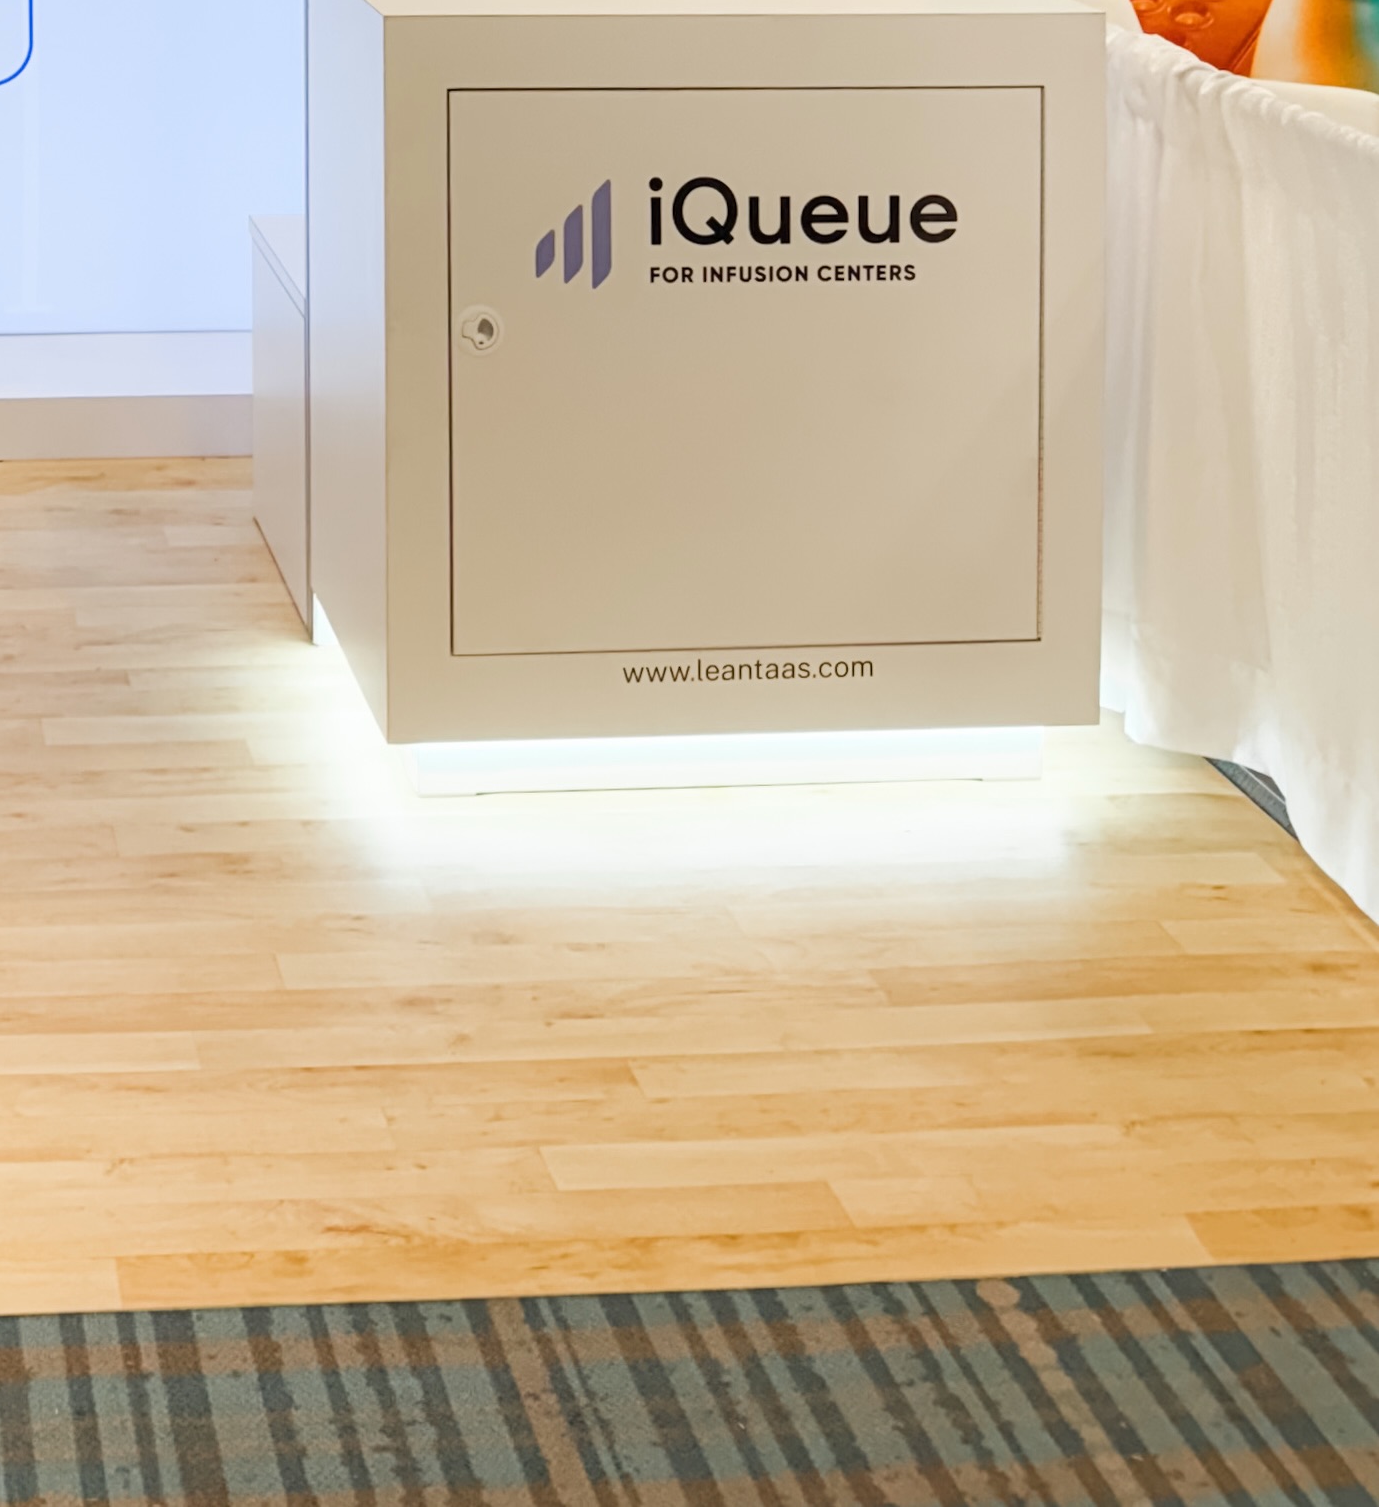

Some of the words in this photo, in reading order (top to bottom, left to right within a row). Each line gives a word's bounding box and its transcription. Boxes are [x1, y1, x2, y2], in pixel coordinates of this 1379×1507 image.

[648, 176, 958, 247] iQueue
[649, 265, 695, 284] FOR
[702, 265, 809, 284] INFUSION
[817, 263, 917, 283] CENTERS
[622, 657, 874, 685] www.leantaas.com
